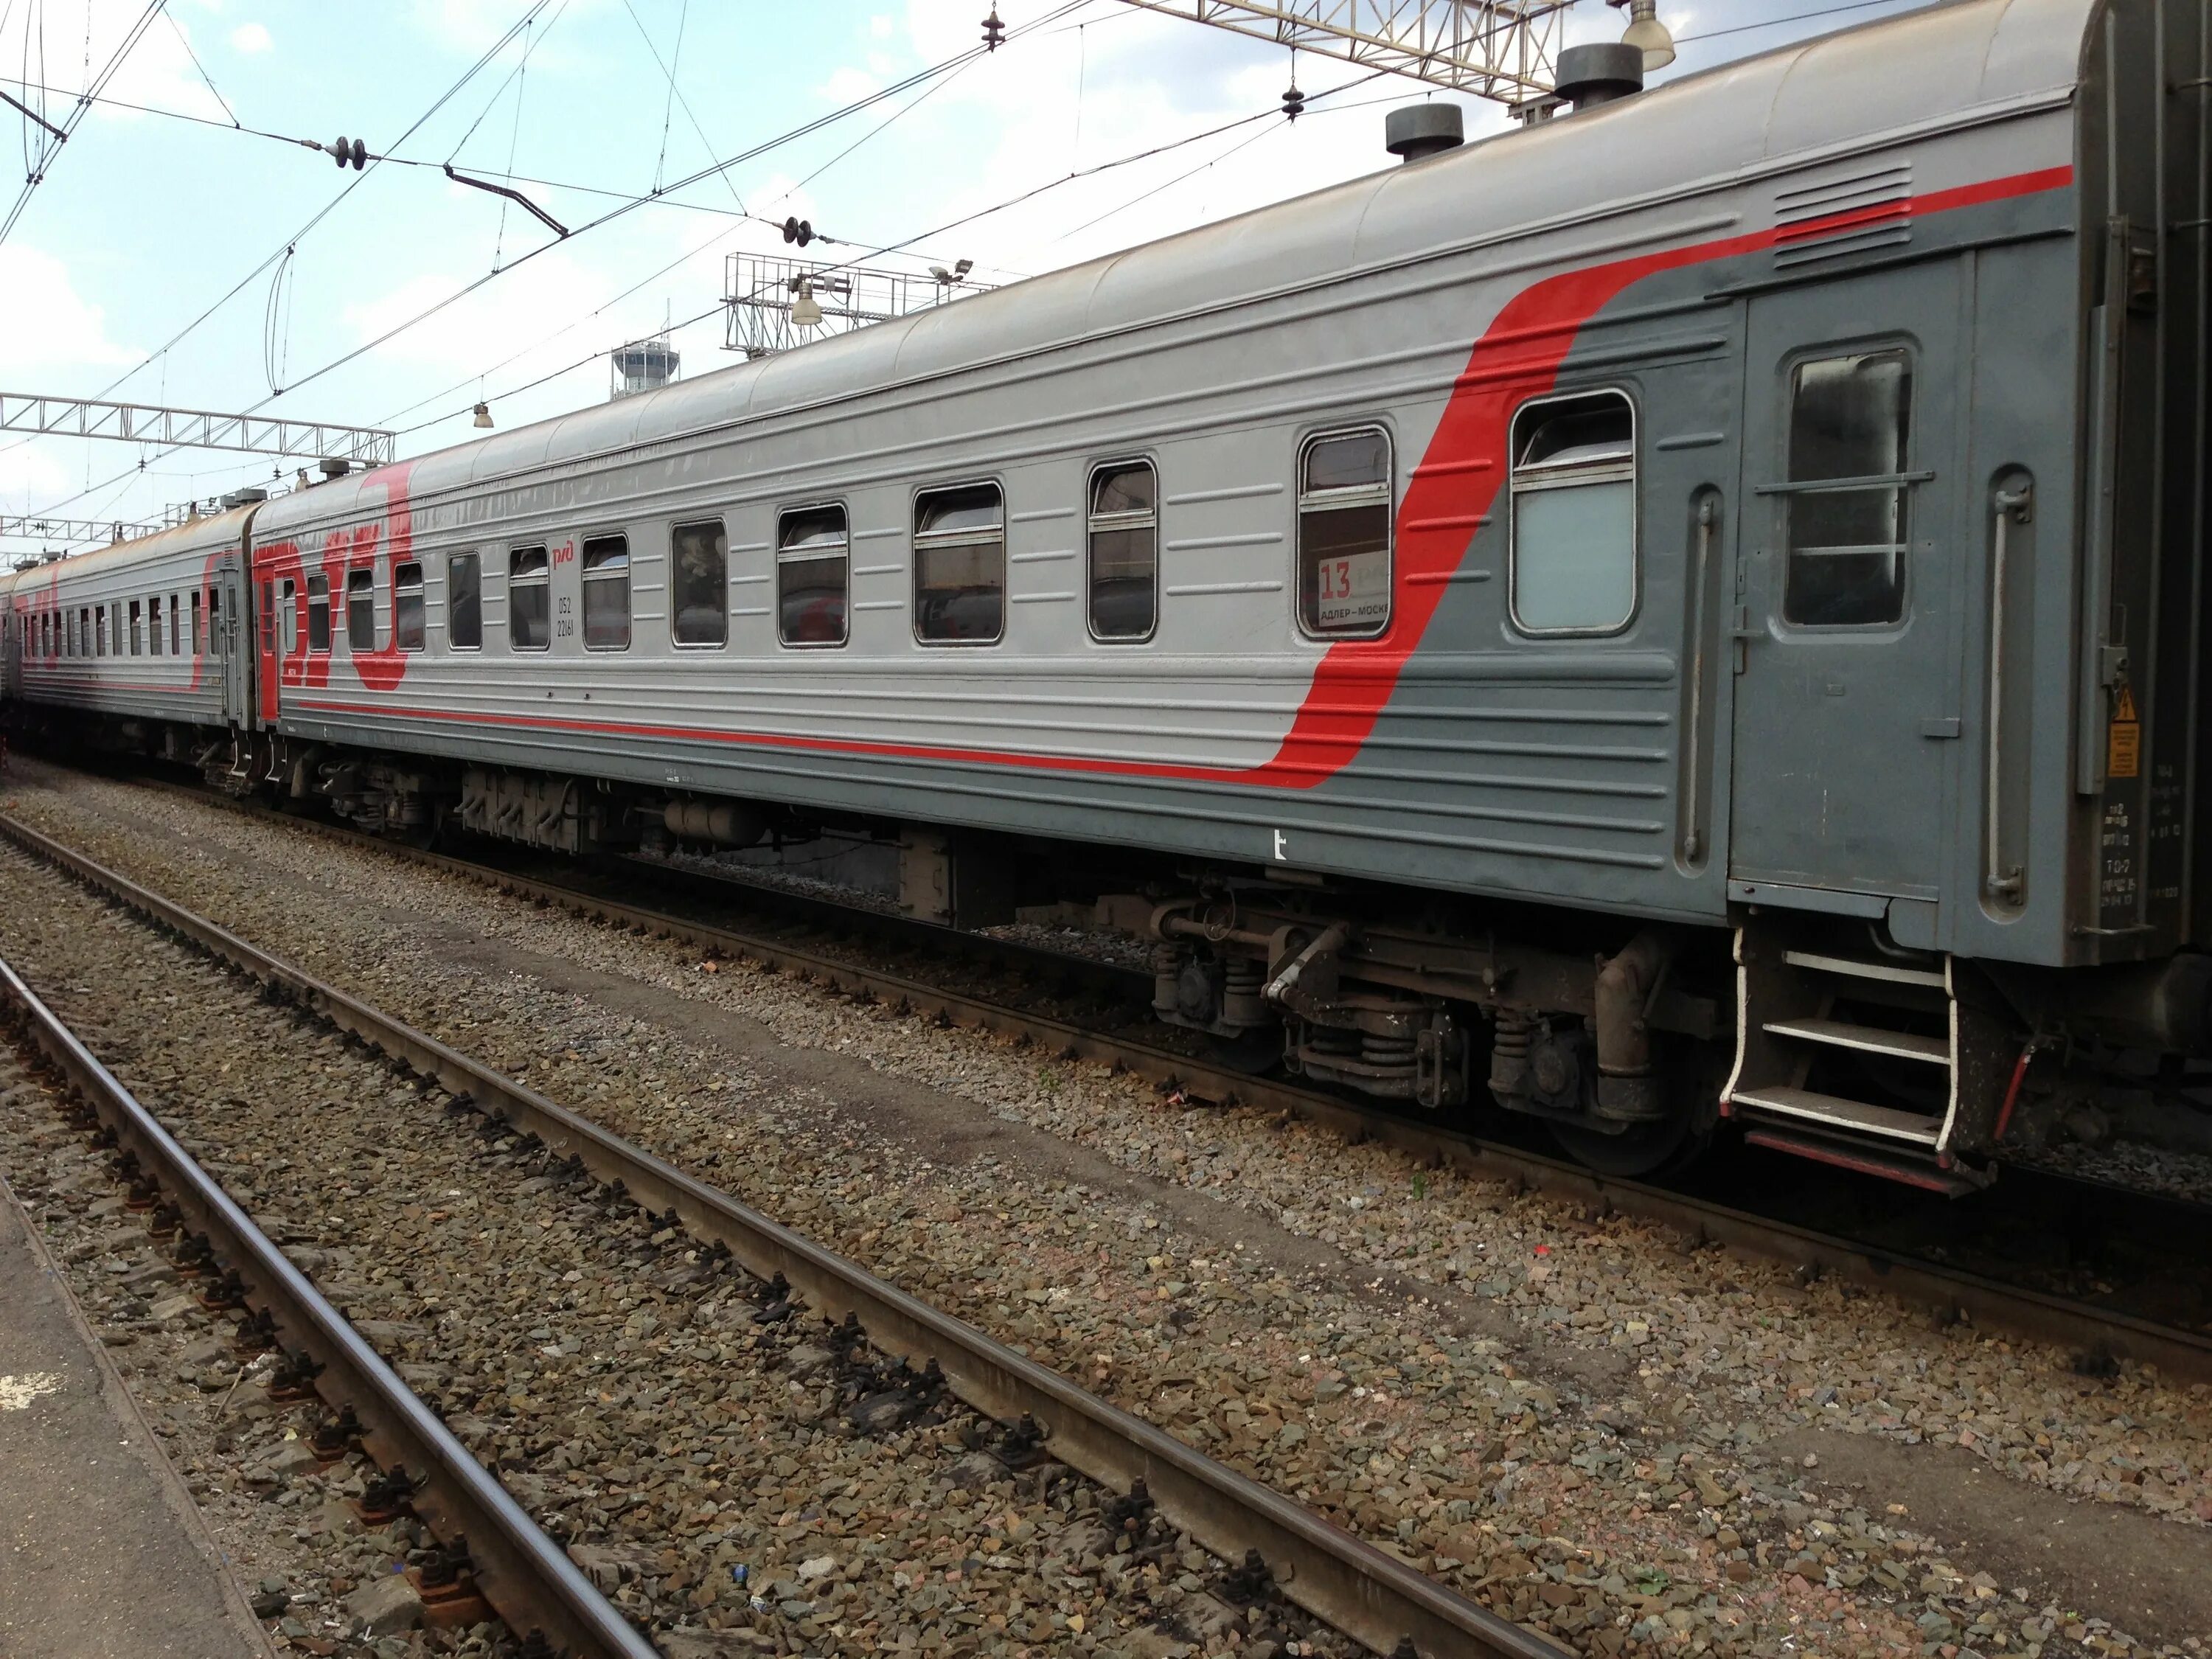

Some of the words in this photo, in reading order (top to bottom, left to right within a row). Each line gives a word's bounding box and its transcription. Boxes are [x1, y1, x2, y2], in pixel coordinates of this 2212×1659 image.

[1321, 561, 1350, 599] 13
[559, 597, 571, 613] 052
[557, 619, 574, 637] 22161
